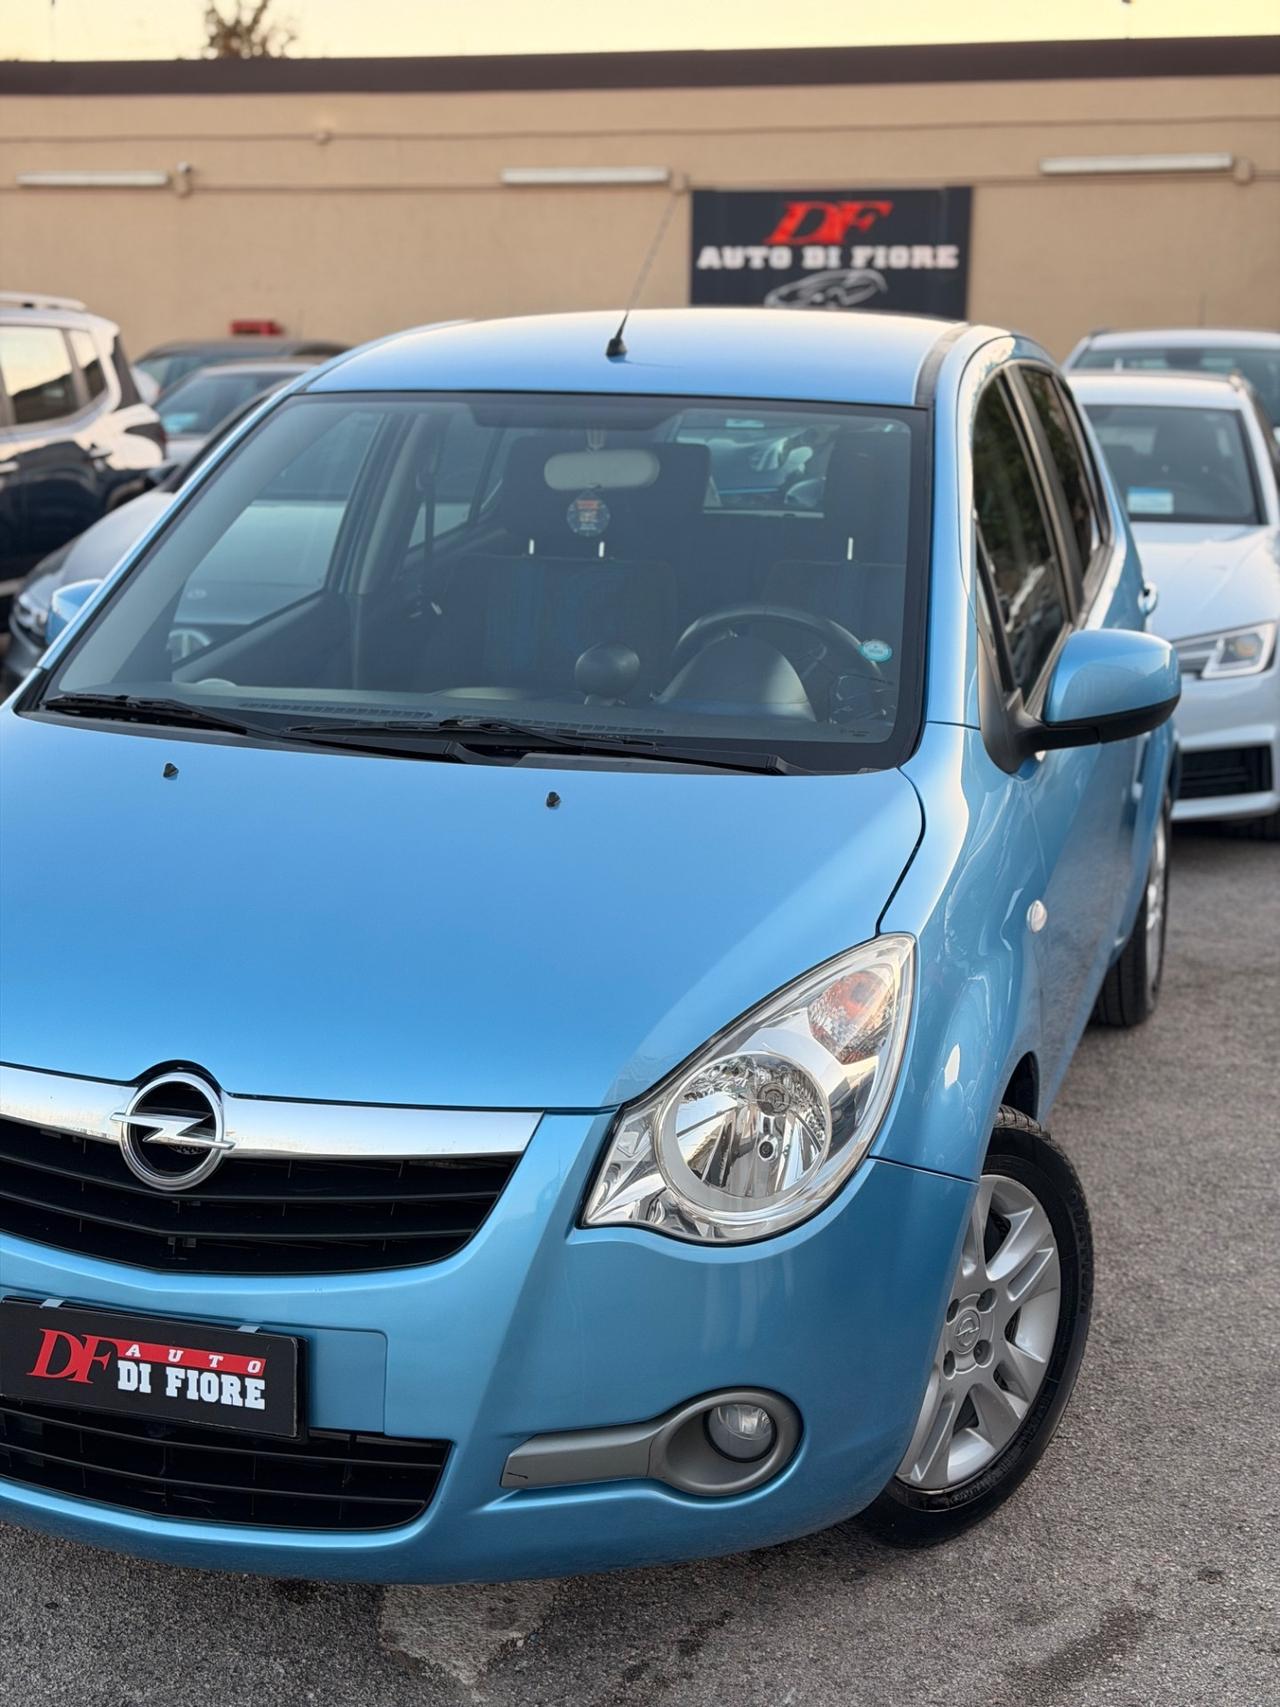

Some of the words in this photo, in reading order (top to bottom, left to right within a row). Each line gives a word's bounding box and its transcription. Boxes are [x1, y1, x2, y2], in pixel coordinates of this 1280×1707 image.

[764, 201, 893, 245] DF
[697, 246, 792, 269] AUTO
[802, 246, 841, 269] DI
[851, 246, 959, 269] FIORE
[26, 1328, 114, 1384] DF
[125, 1344, 261, 1374] AUTO
[117, 1360, 151, 1394] DI
[165, 1366, 266, 1410] FIORE
